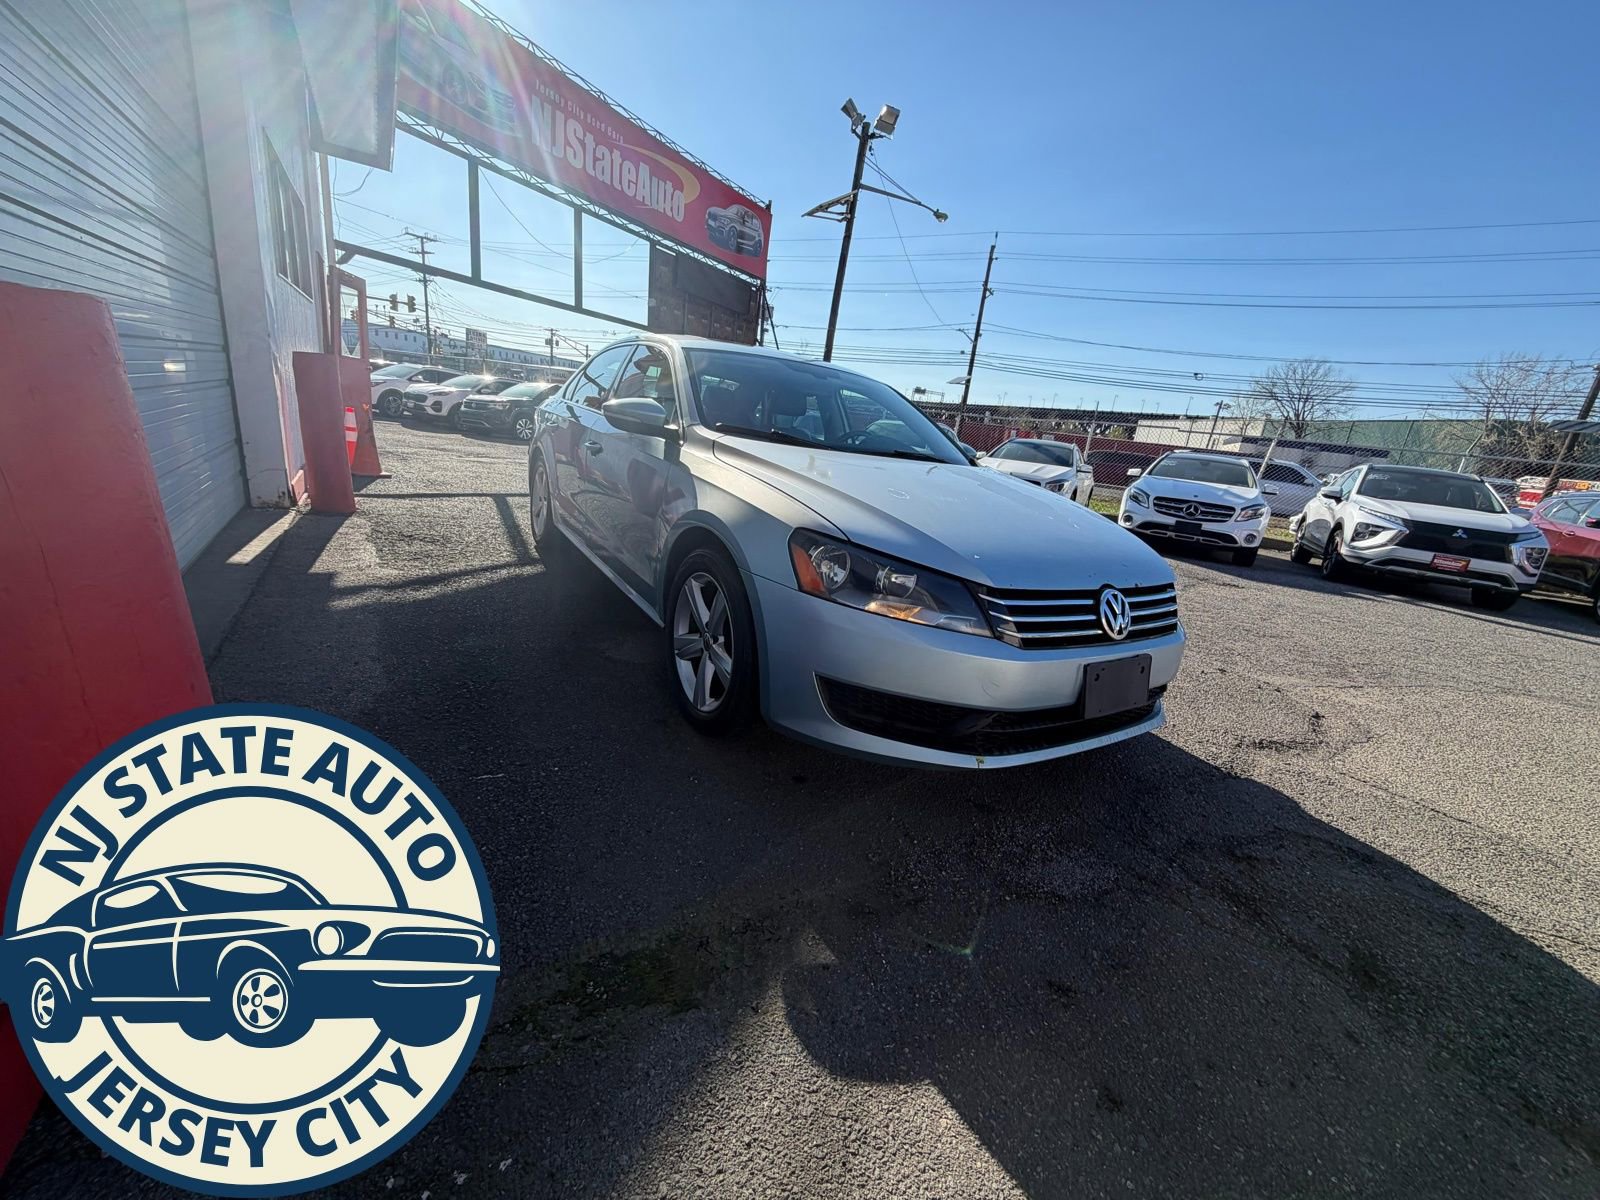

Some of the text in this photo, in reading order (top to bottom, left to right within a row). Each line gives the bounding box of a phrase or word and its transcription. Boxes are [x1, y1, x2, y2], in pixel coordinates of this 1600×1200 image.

[531, 93, 685, 223] NJStateAuto
[568, 100, 585, 119] City
[587, 112, 605, 132] Used
[607, 126, 624, 144] Cars
